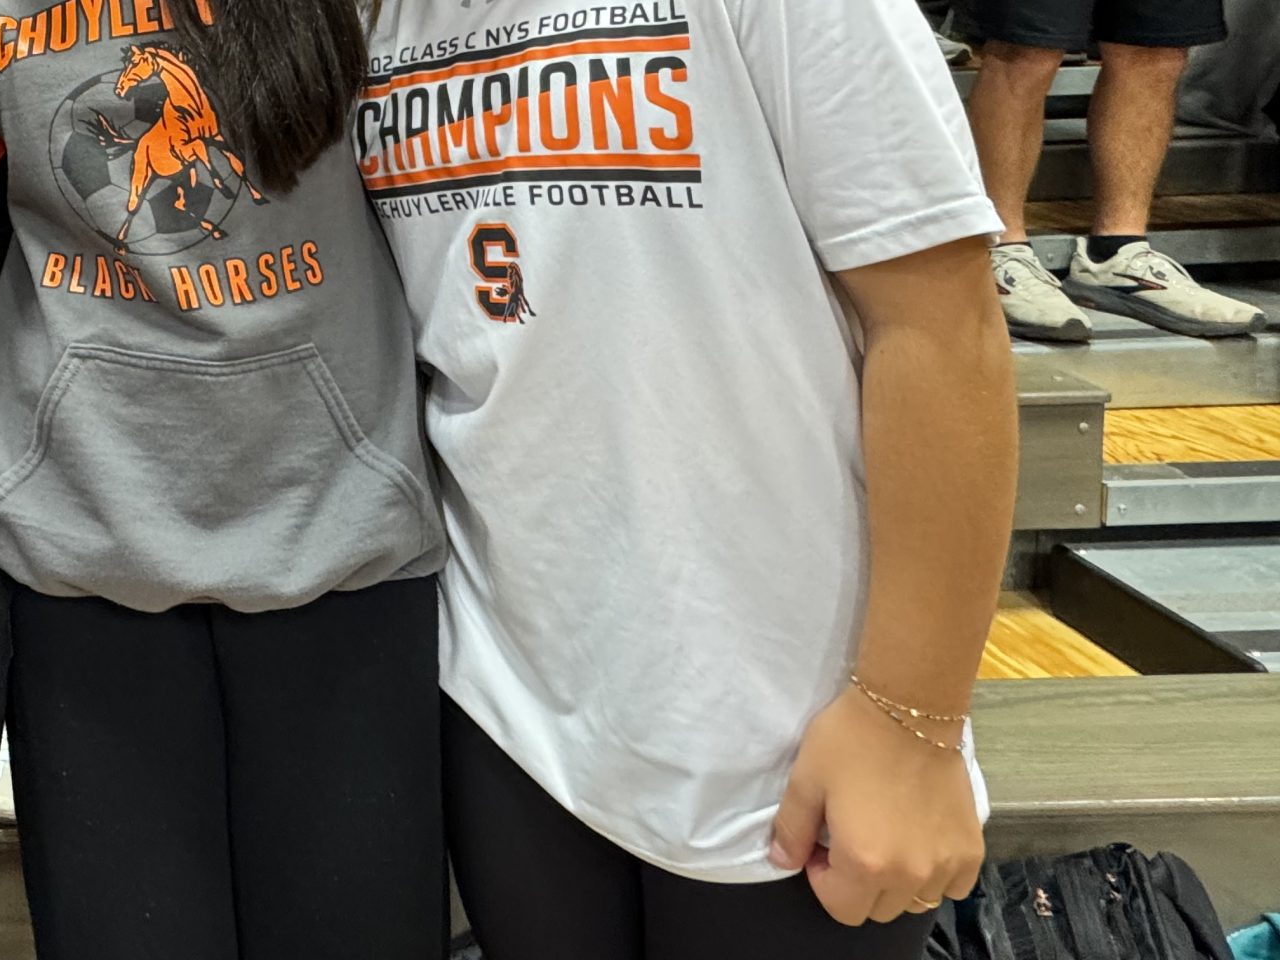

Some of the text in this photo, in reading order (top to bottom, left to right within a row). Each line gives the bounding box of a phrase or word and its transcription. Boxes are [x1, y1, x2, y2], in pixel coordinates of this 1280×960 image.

[365, 54, 394, 75] 02
[399, 32, 458, 64] CLASS
[464, 31, 477, 50] C
[485, 21, 531, 47] NYS
[355, 55, 695, 177] CHAMPIONS
[528, 184, 704, 209] FOOTBALL
[40, 239, 324, 312] BLACK HORSES
[466, 222, 522, 324] S
